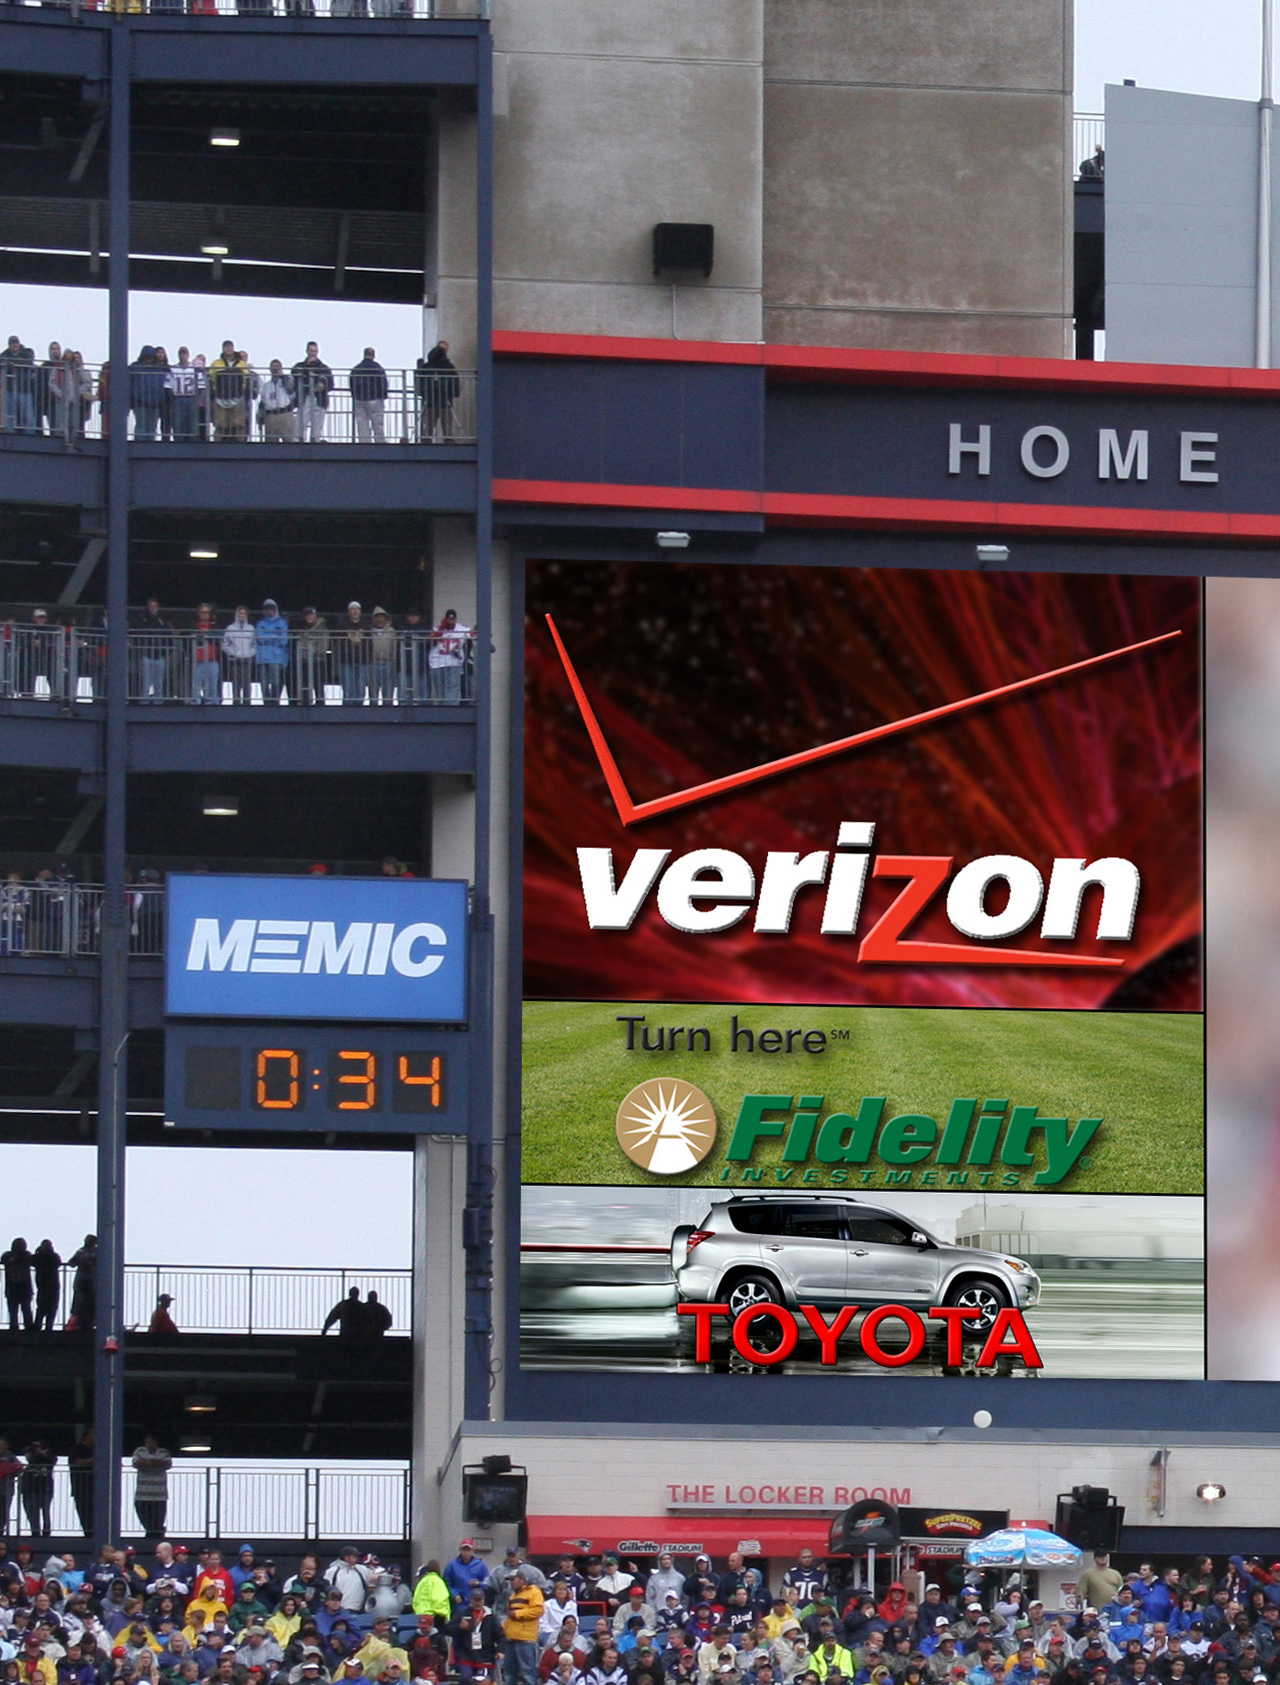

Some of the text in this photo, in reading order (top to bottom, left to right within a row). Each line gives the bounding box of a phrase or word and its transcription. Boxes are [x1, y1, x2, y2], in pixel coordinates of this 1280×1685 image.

[947, 423, 1219, 483] HOME
[575, 821, 1141, 965] verizon
[186, 918, 447, 978] MEMIC
[616, 1014, 711, 1053] Turn
[730, 1014, 828, 1054] here
[256, 1048, 441, 1110] 0:34
[724, 1094, 1104, 1187] Fidelity
[720, 1167, 1022, 1188] INVESTMENTS
[676, 1302, 1045, 1369] TOYOTA
[666, 1483, 912, 1506] THE LOCKER ROOM
[617, 1540, 704, 1554] Gillette STADIUM
